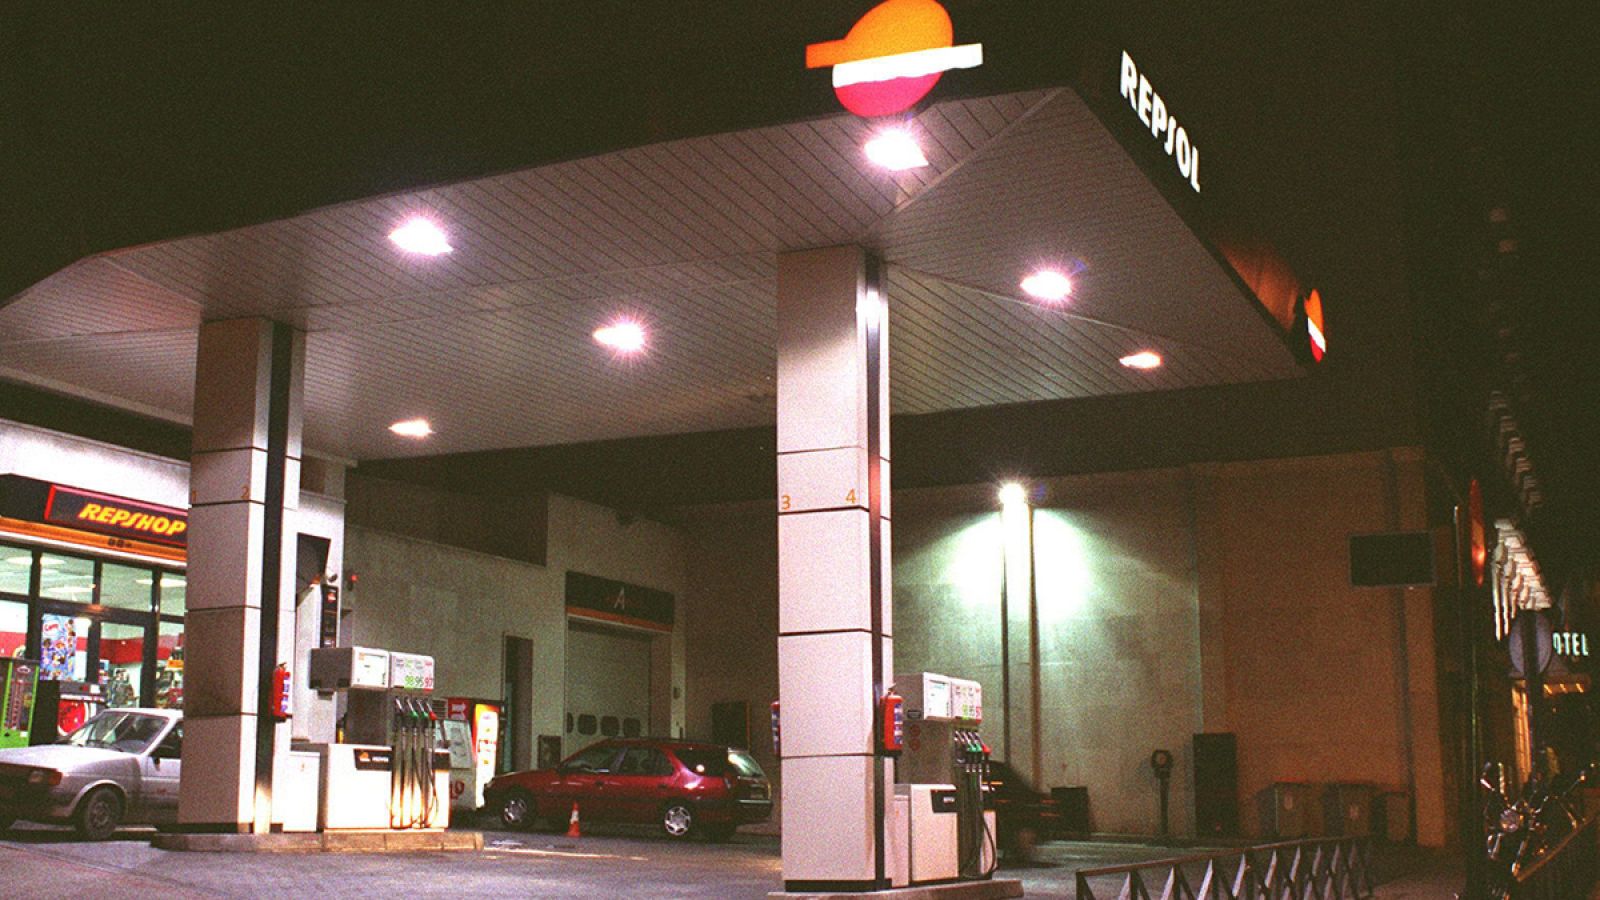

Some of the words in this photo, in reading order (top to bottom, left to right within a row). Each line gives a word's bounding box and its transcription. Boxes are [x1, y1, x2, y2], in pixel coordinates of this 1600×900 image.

[1120, 50, 1200, 193] REPSOL
[781, 495, 791, 510] 3
[846, 488, 856, 504] 4
[78, 503, 187, 536] REPSHOP
